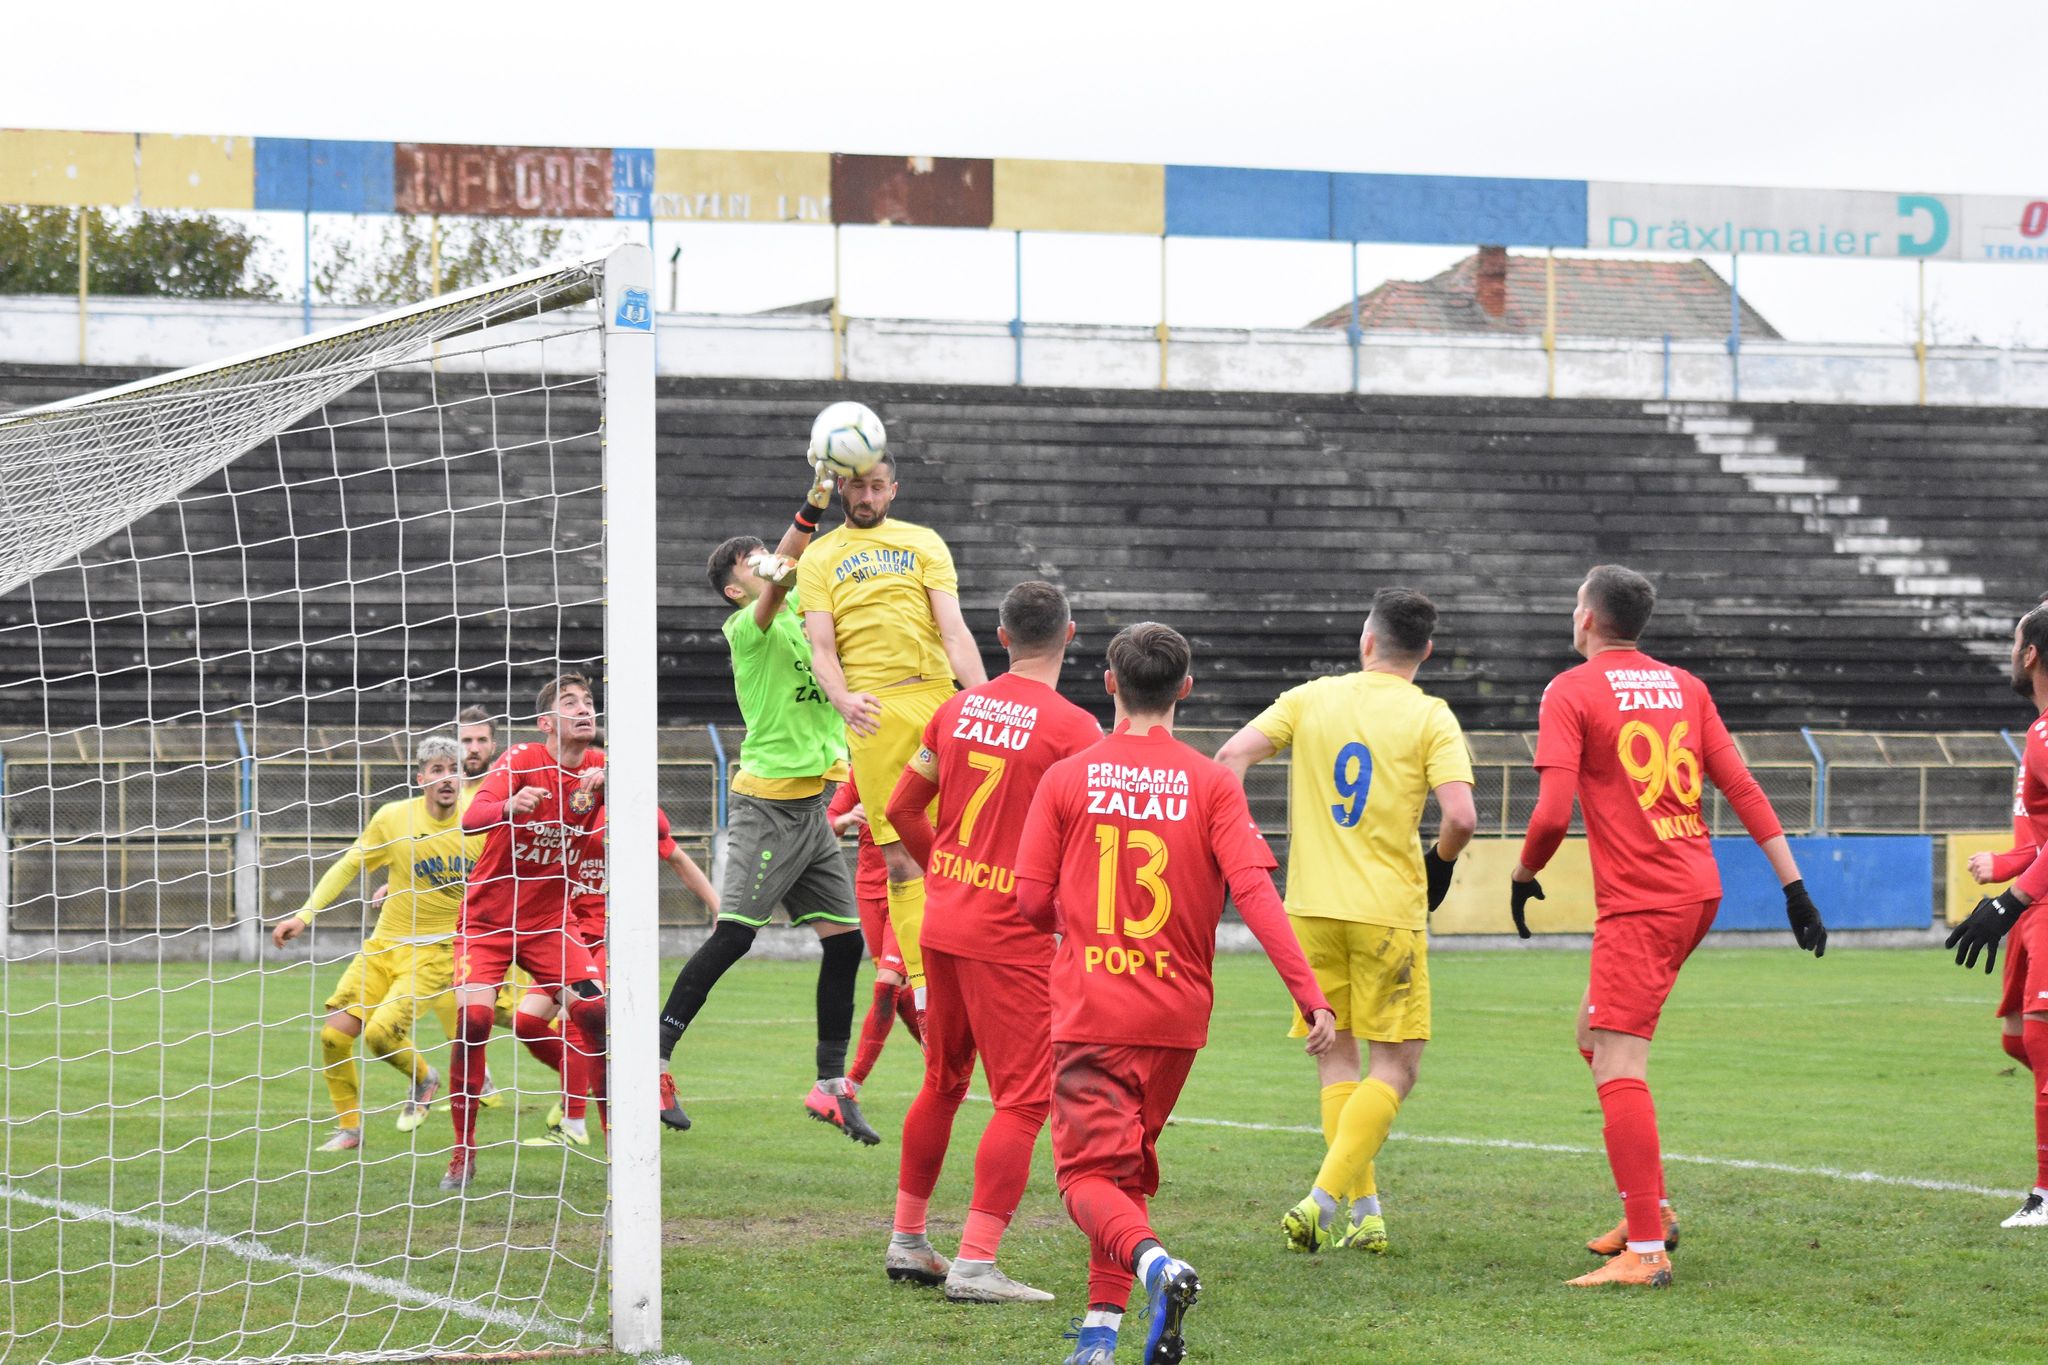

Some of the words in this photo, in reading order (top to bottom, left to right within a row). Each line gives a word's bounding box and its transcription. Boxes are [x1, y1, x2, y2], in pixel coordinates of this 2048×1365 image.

[1608, 216, 1880, 256] Dräxlmaier
[875, 549, 915, 572] LOCAL
[960, 706, 1036, 730] MUNICIPIULUI
[1330, 741, 1373, 828] 9
[1617, 719, 1703, 811] 96
[958, 750, 1006, 848] 7
[1087, 777, 1189, 796] MUNICIPIULUI
[930, 849, 1016, 895] STANCIU
[1095, 823, 1172, 940] 13
[1084, 945, 1146, 975] POP
[1154, 950, 1177, 979] F.
[663, 1015, 685, 1030] JAKO
